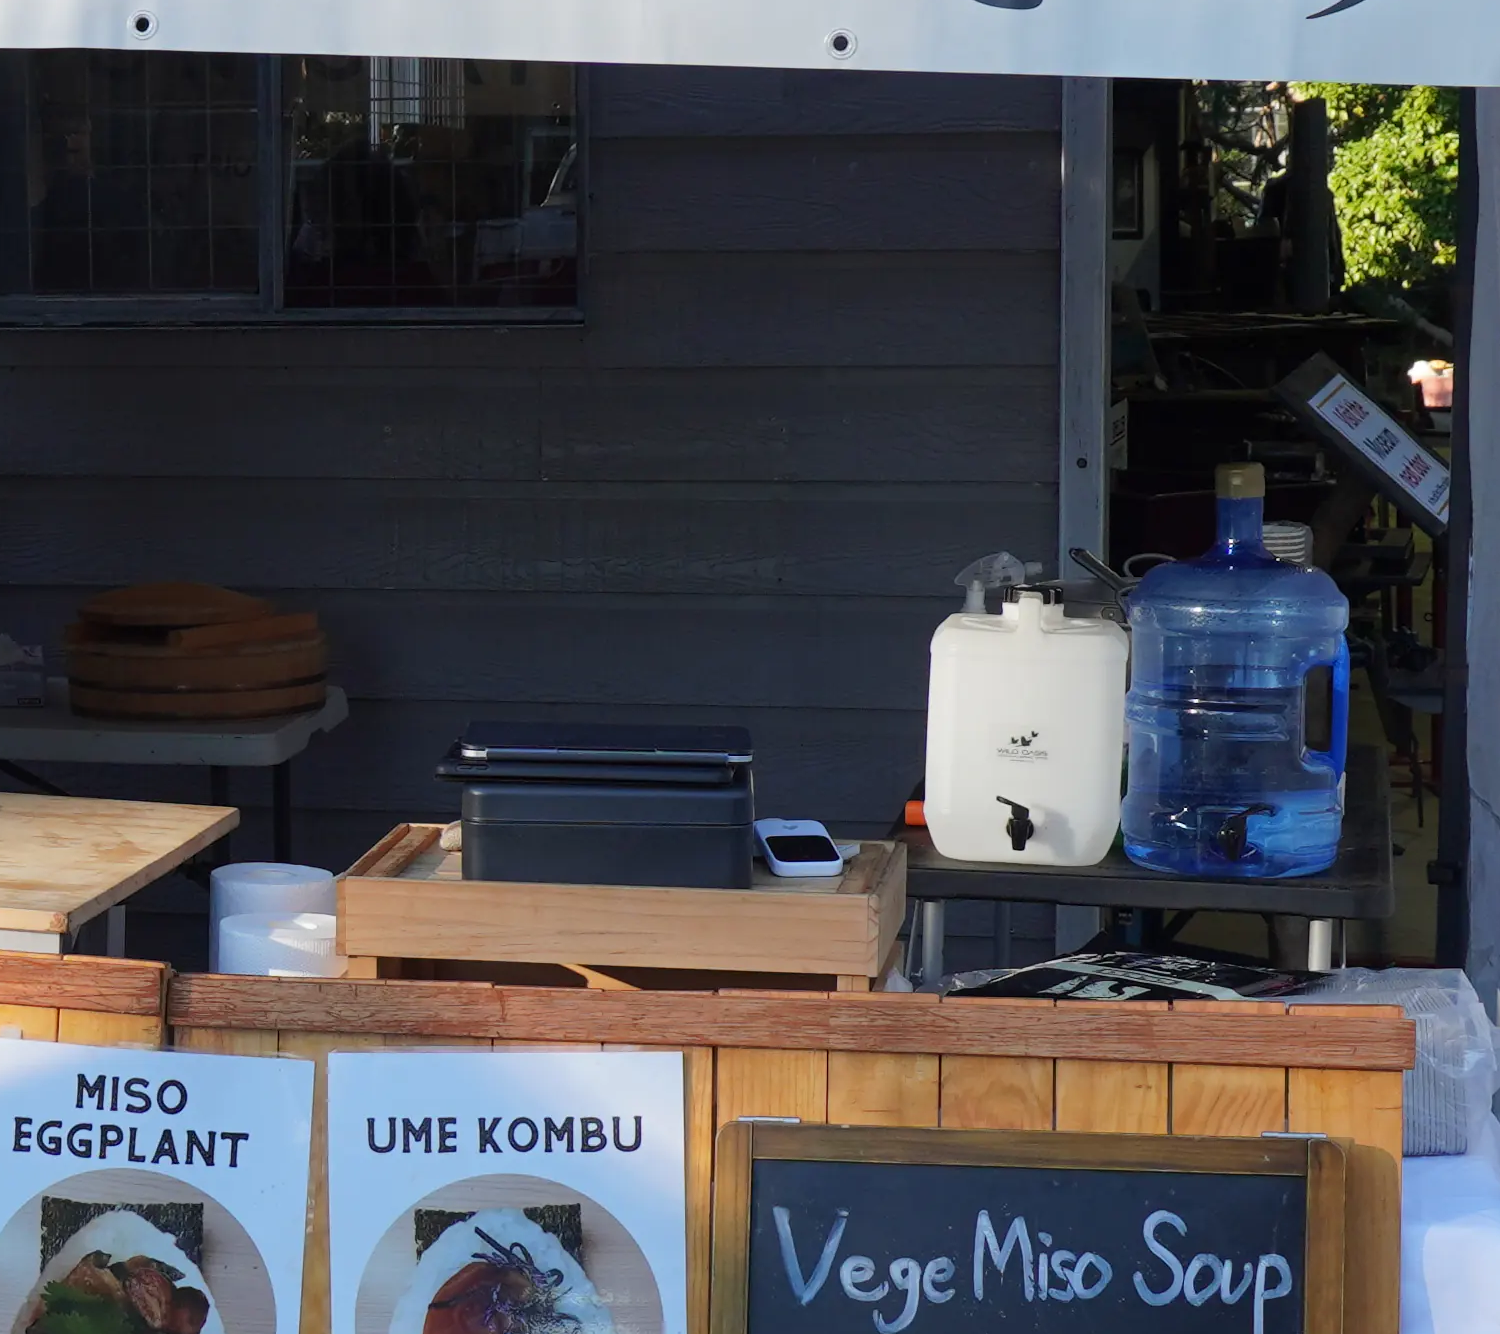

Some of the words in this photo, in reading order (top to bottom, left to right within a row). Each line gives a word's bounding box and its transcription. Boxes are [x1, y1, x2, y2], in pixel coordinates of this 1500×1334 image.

[75, 1073, 188, 1115] MISO
[12, 1117, 249, 1168] EGGPLANT
[366, 1115, 458, 1154] UME
[478, 1115, 643, 1154] KOMBU
[973, 1208, 1113, 1304] Miso
